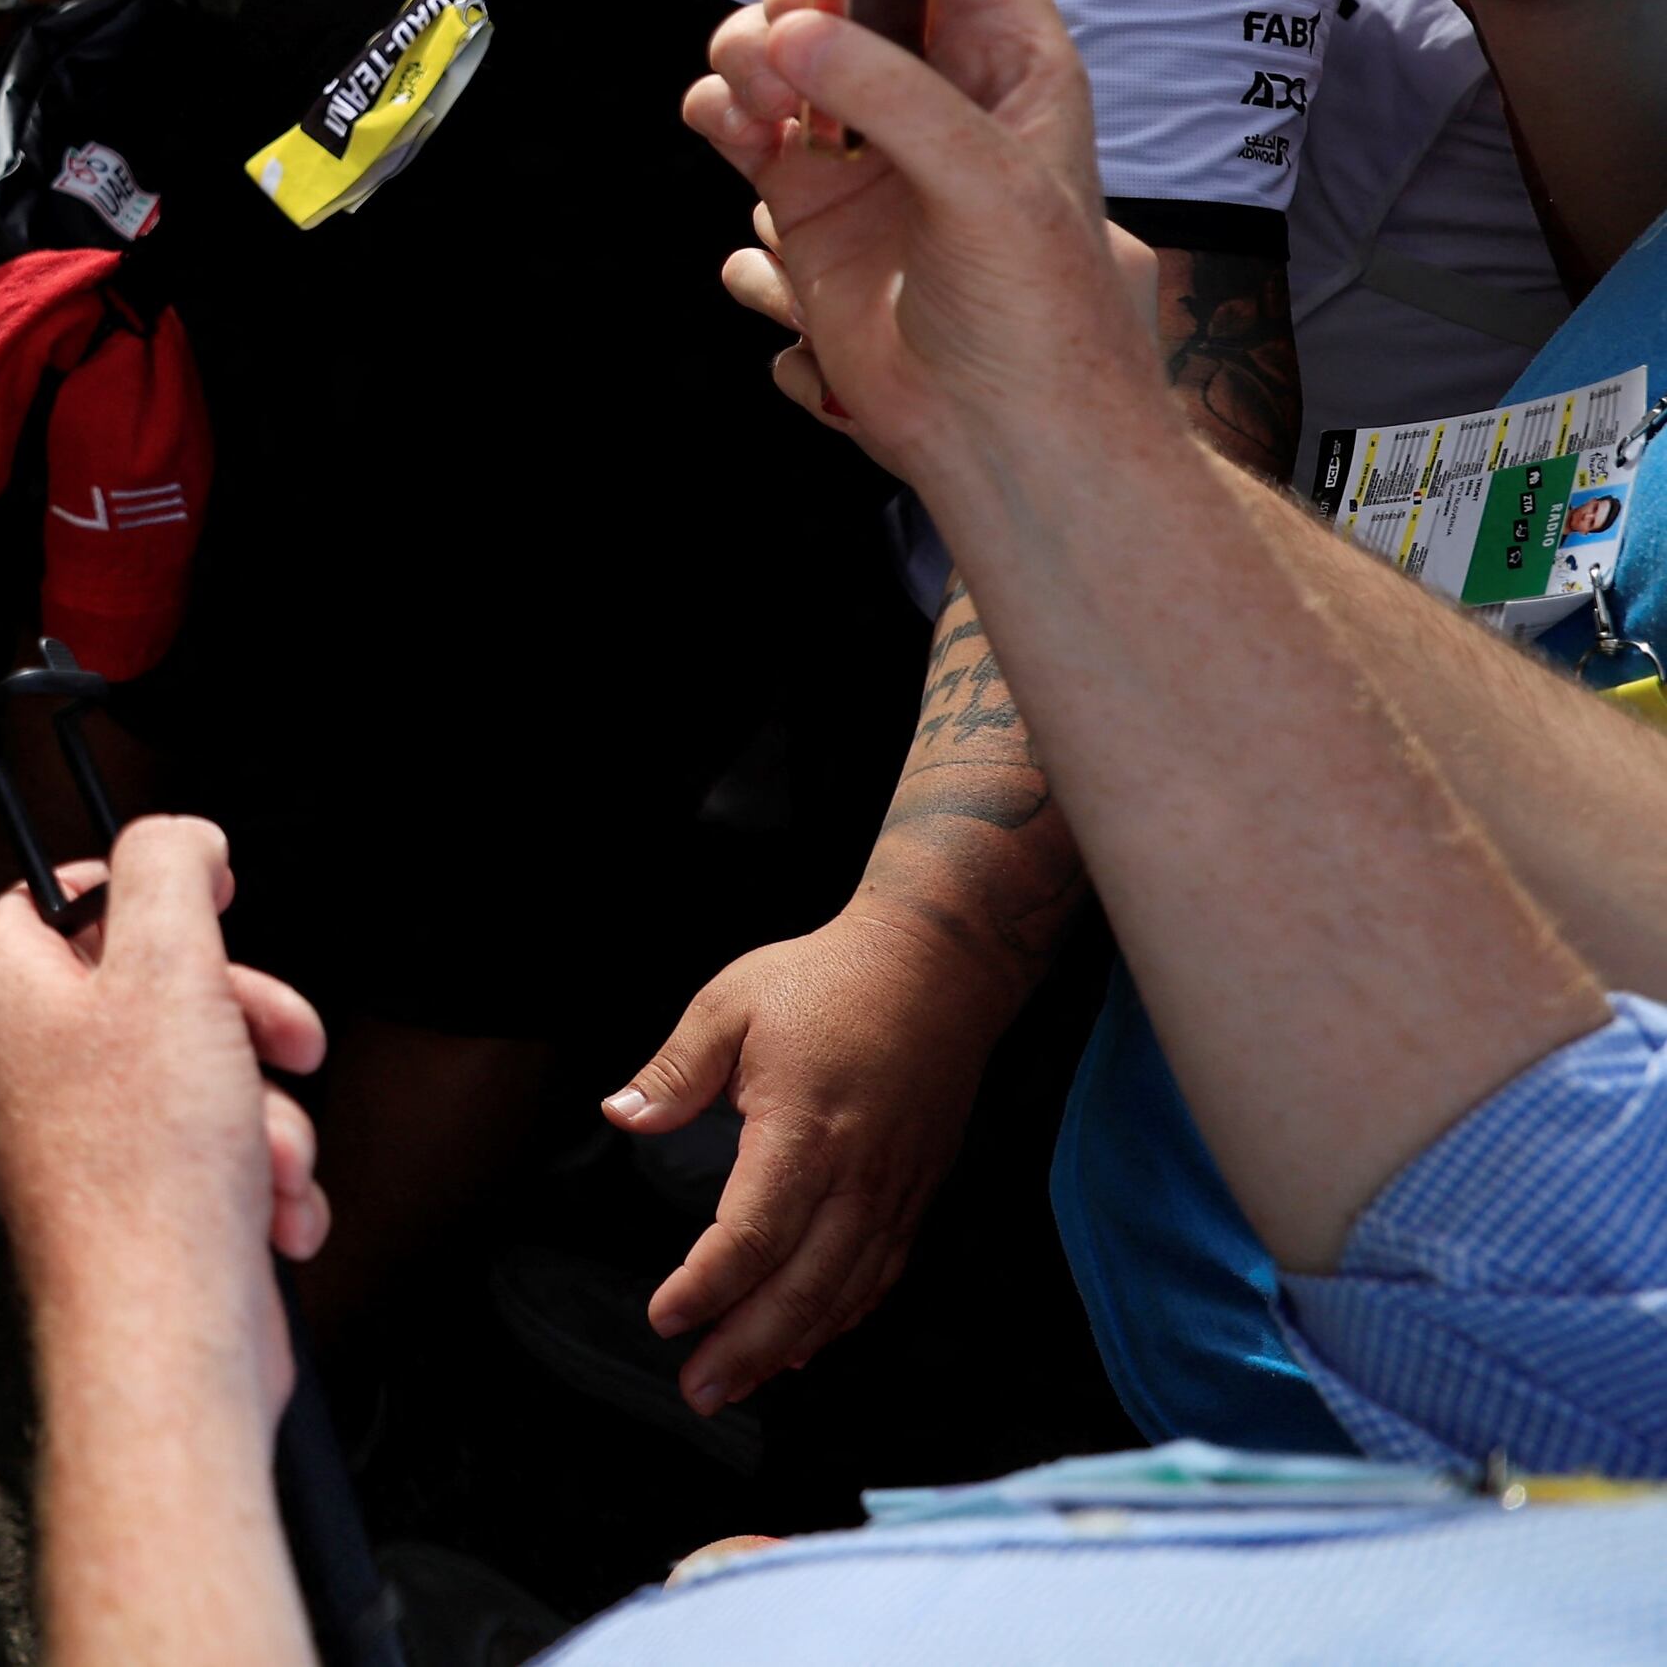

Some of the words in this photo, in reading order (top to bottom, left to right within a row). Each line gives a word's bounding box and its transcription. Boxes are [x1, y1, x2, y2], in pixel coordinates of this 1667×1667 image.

[1238, 147, 1276, 165] ADNOC
[94, 165, 134, 217] UAE
[1327, 464, 1338, 486] UCI
[1542, 503, 1563, 547] RADIO
